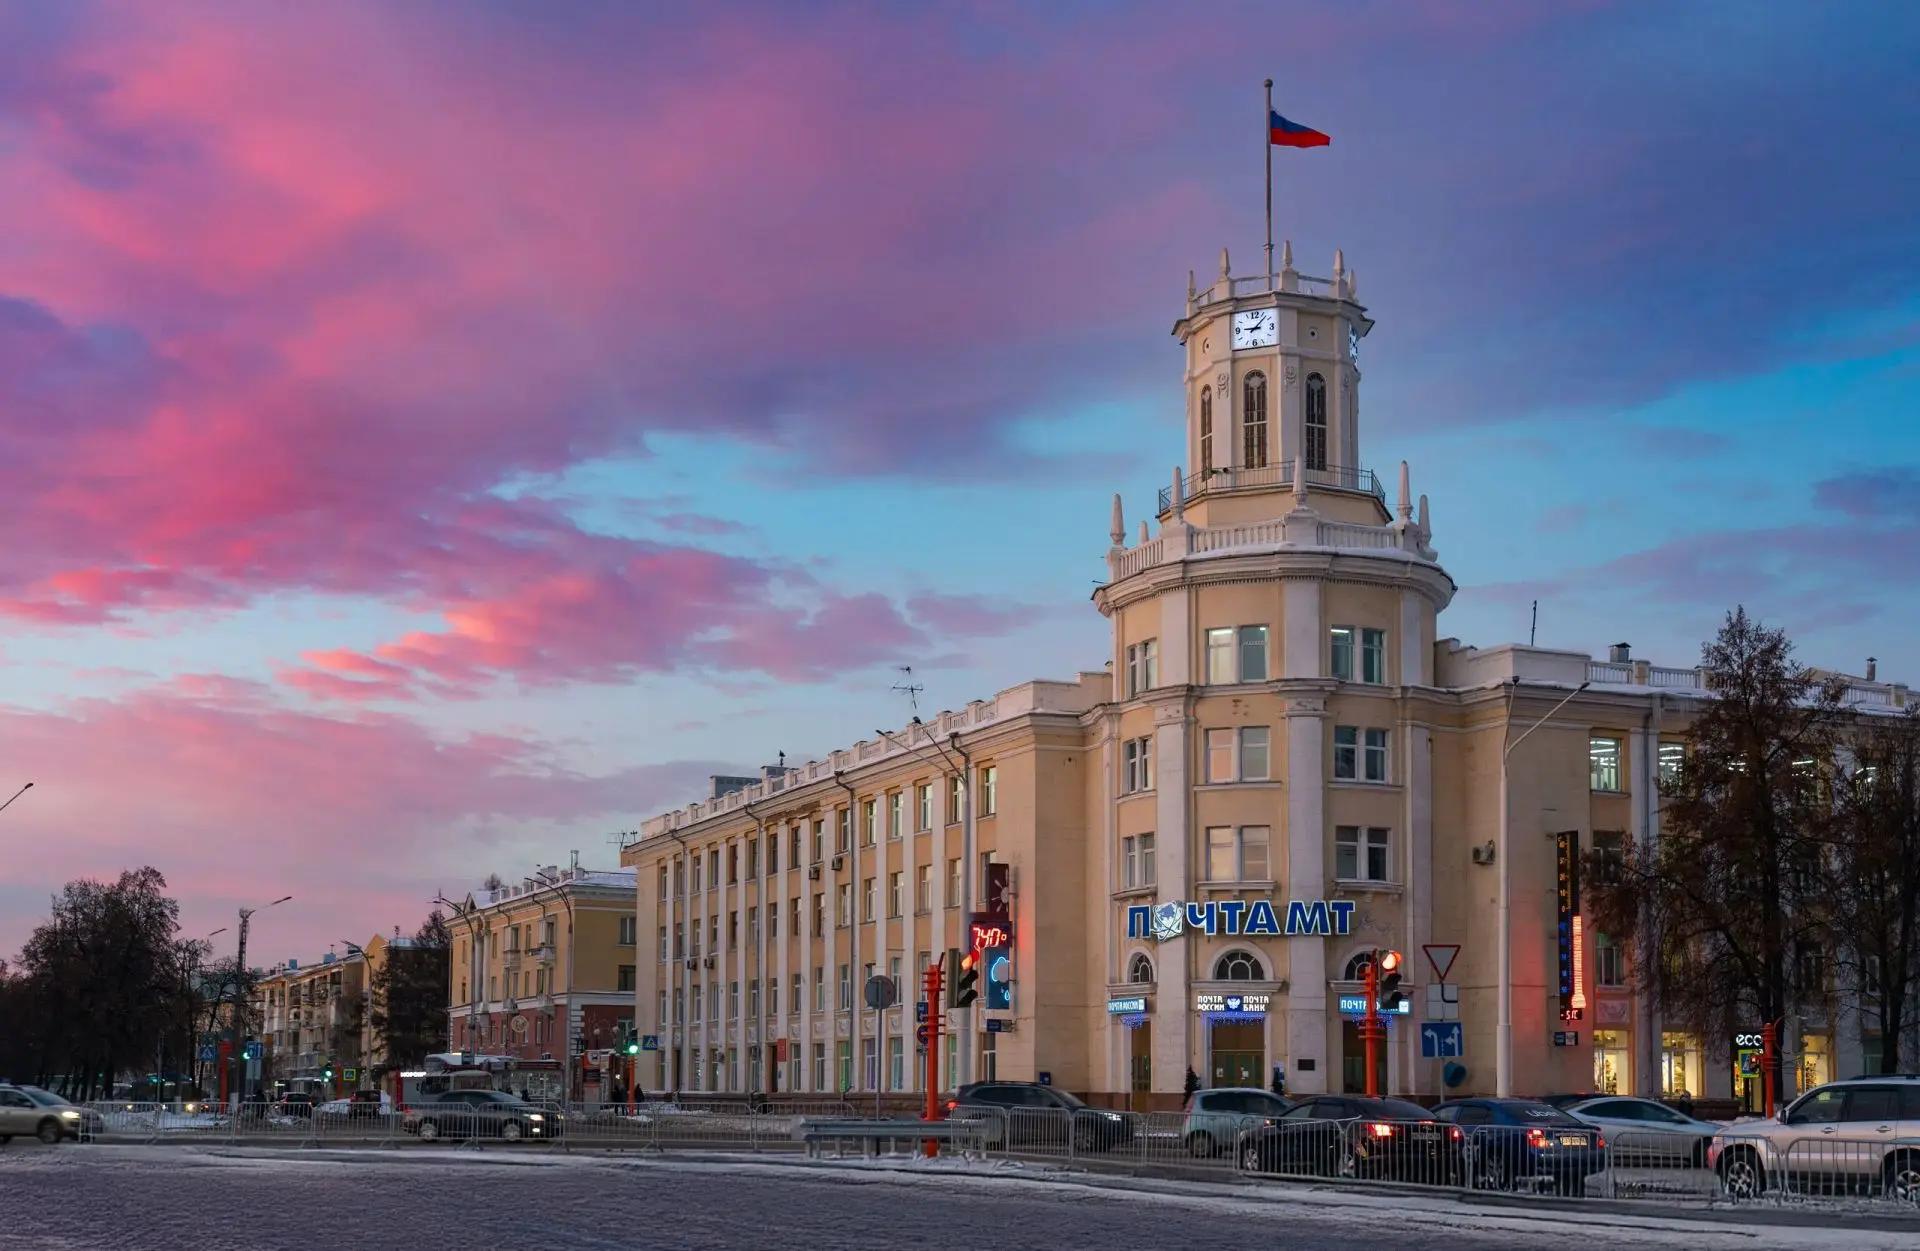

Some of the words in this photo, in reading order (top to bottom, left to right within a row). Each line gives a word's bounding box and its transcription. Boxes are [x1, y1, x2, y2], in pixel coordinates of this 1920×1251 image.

[1251, 311, 1260, 319] 12
[1252, 338, 1258, 346] 6
[1735, 1034, 1763, 1046] ecc
